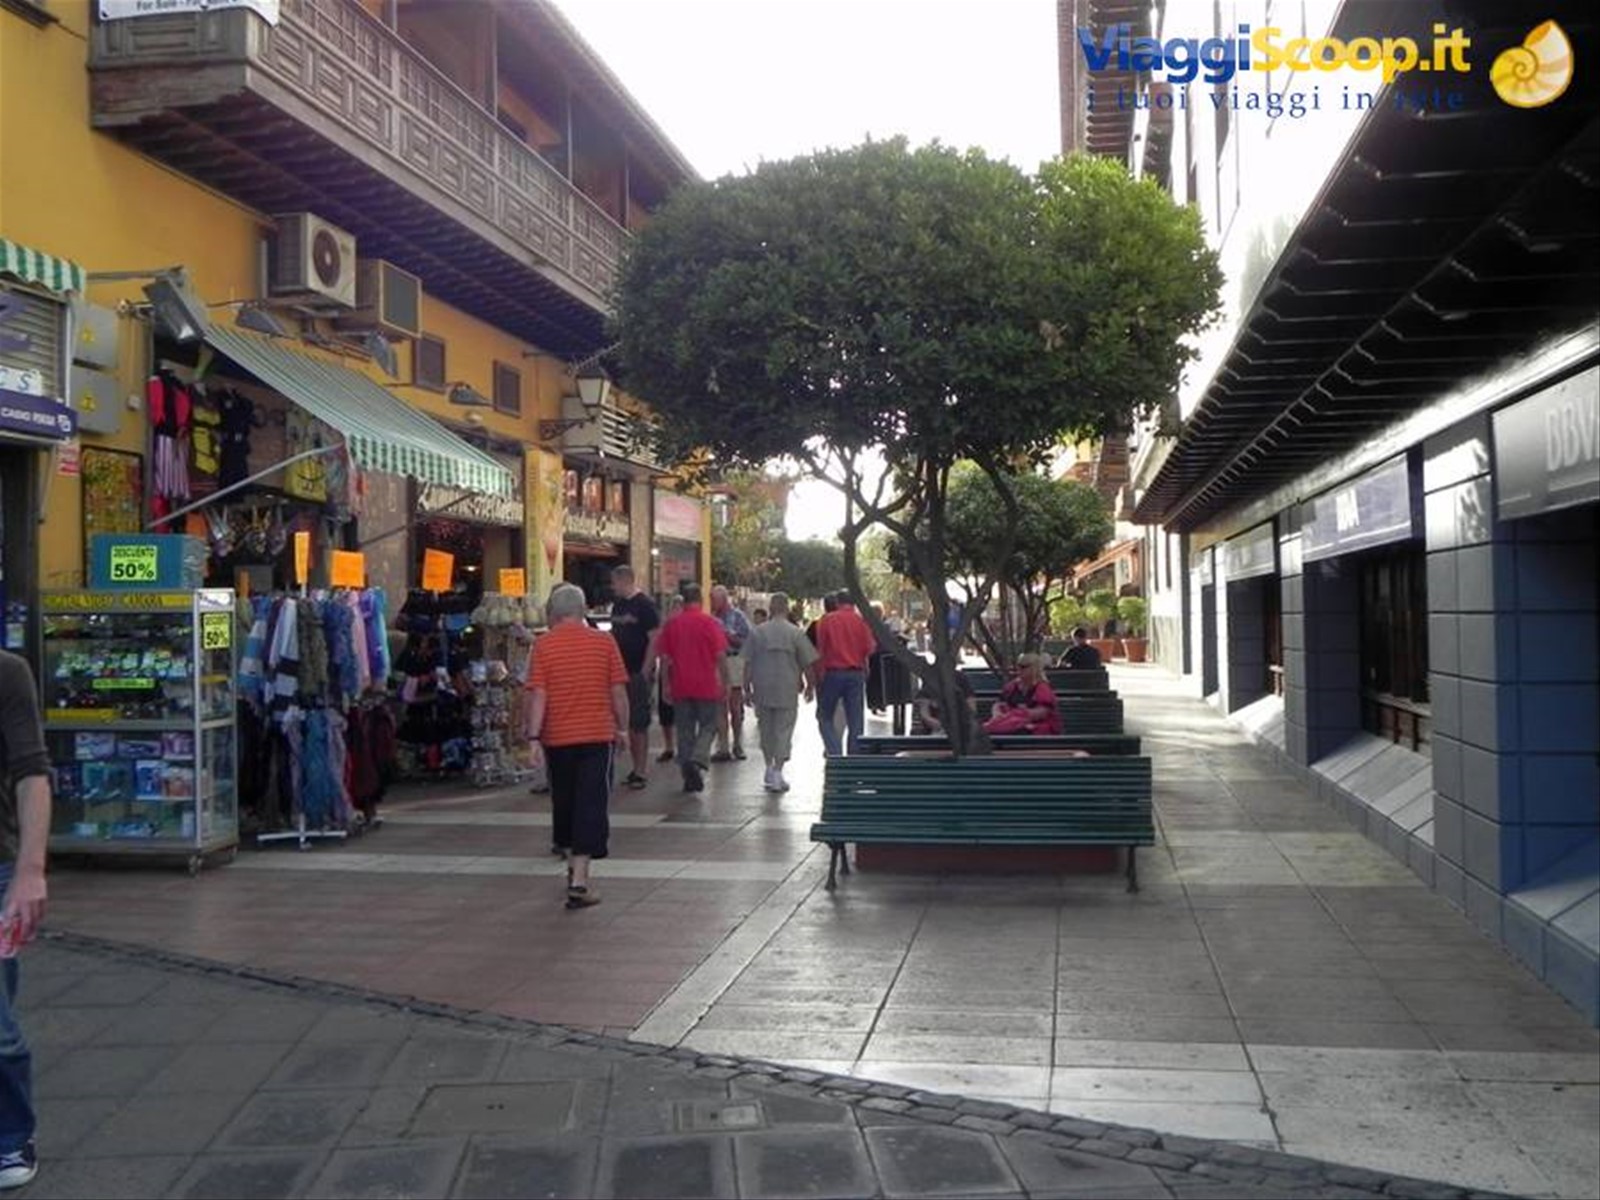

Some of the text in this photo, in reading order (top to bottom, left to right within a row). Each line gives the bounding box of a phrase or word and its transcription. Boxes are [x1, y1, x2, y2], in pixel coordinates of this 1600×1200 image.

[1545, 388, 1600, 471] BBV
[114, 562, 154, 578] 50%
[206, 631, 228, 646] 50%
